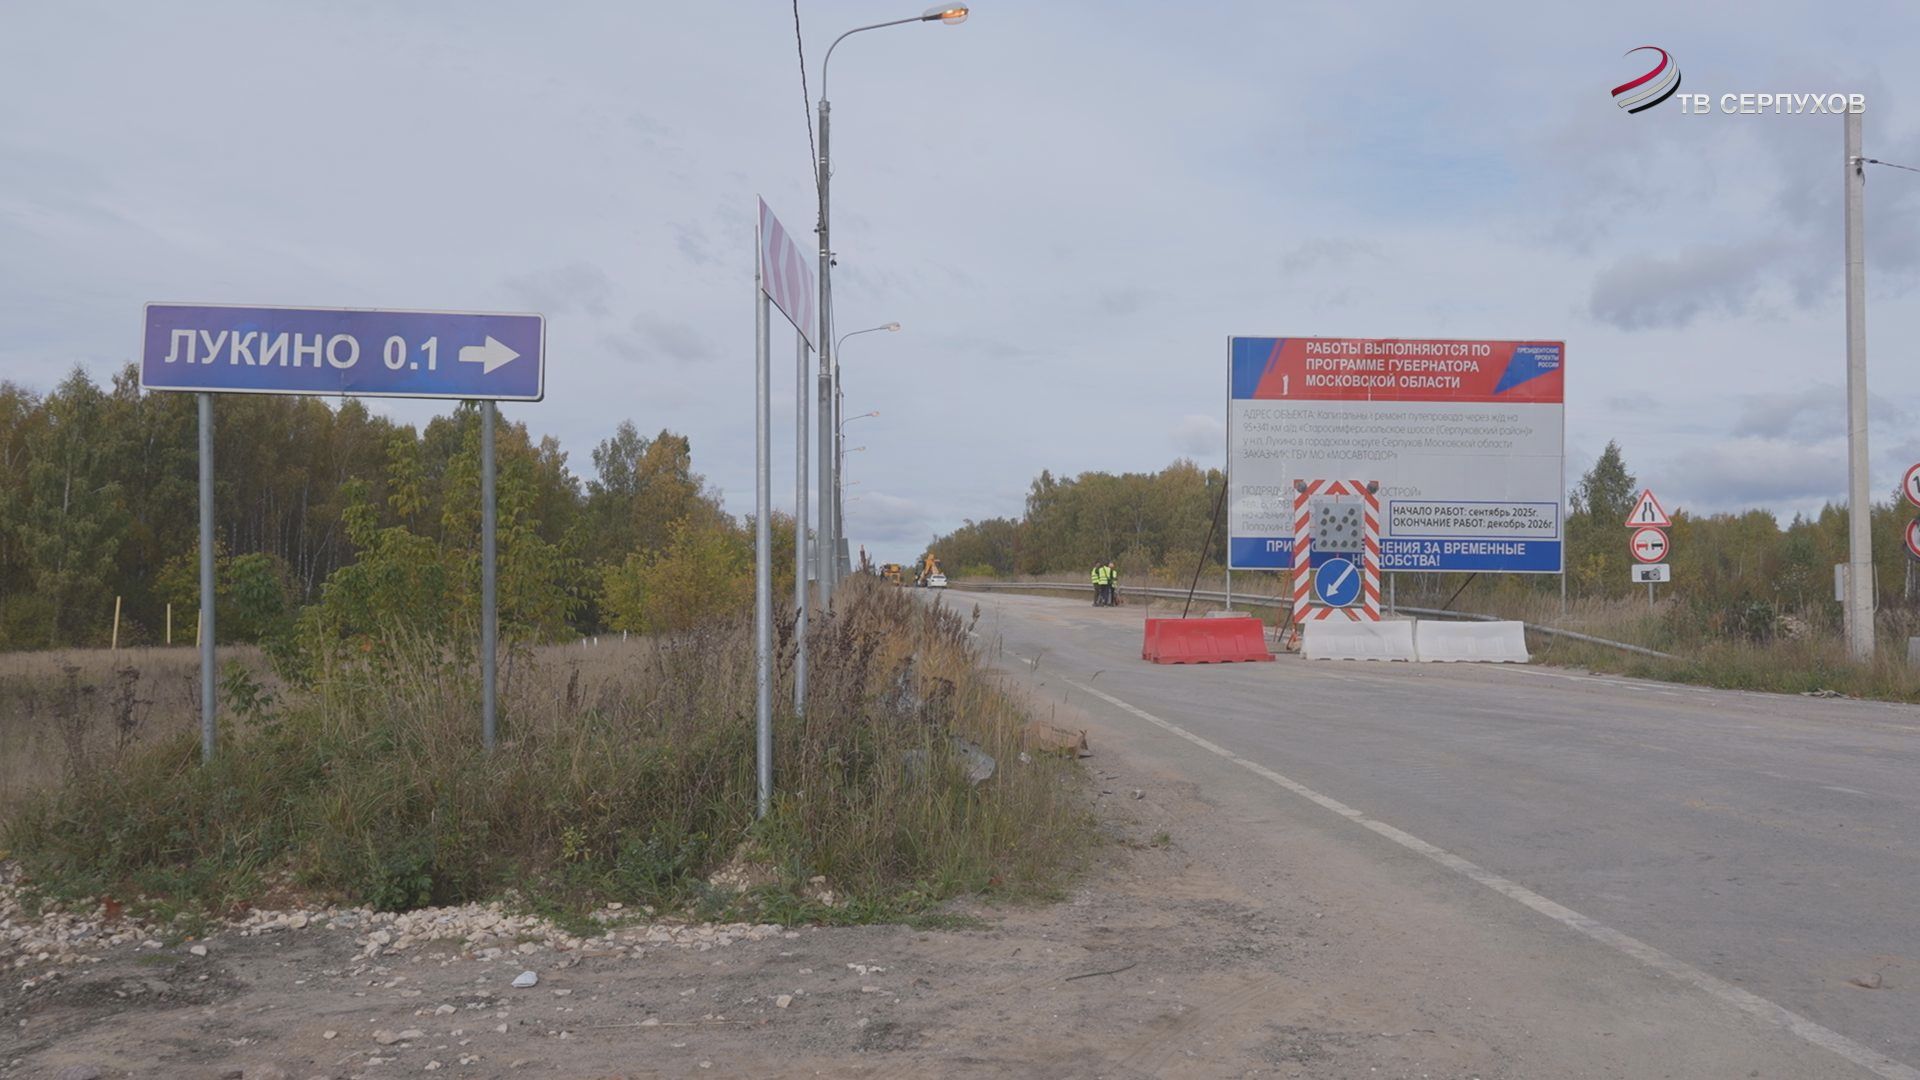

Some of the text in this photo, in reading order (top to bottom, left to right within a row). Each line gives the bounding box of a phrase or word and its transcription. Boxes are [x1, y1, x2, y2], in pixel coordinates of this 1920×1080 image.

[164, 329, 439, 370] ЛУКИНО 0.1
[1306, 342, 1491, 356] РАБОТЫ ВЫПОЛНЯЮТСЯ ПО
[1306, 358, 1480, 372] ПРОГРАММЕ ГУБЕРНАТОРА
[1306, 373, 1460, 388] МОСКОВСКОЙ ОБЛАСТИ
[1243, 409, 1273, 420] АДРЕС
[1266, 436, 1297, 446] Лукино
[1393, 506, 1539, 518] НАЧАЛО РАБОТ: сентябрь 2025г.
[1392, 518, 1555, 529] ОКОНЧАНИЕ РАБОТ: декабрь 2026г.
[1424, 542, 1441, 553] ЗА
[1444, 542, 1526, 555] ВРЕМЕННЫЕ
